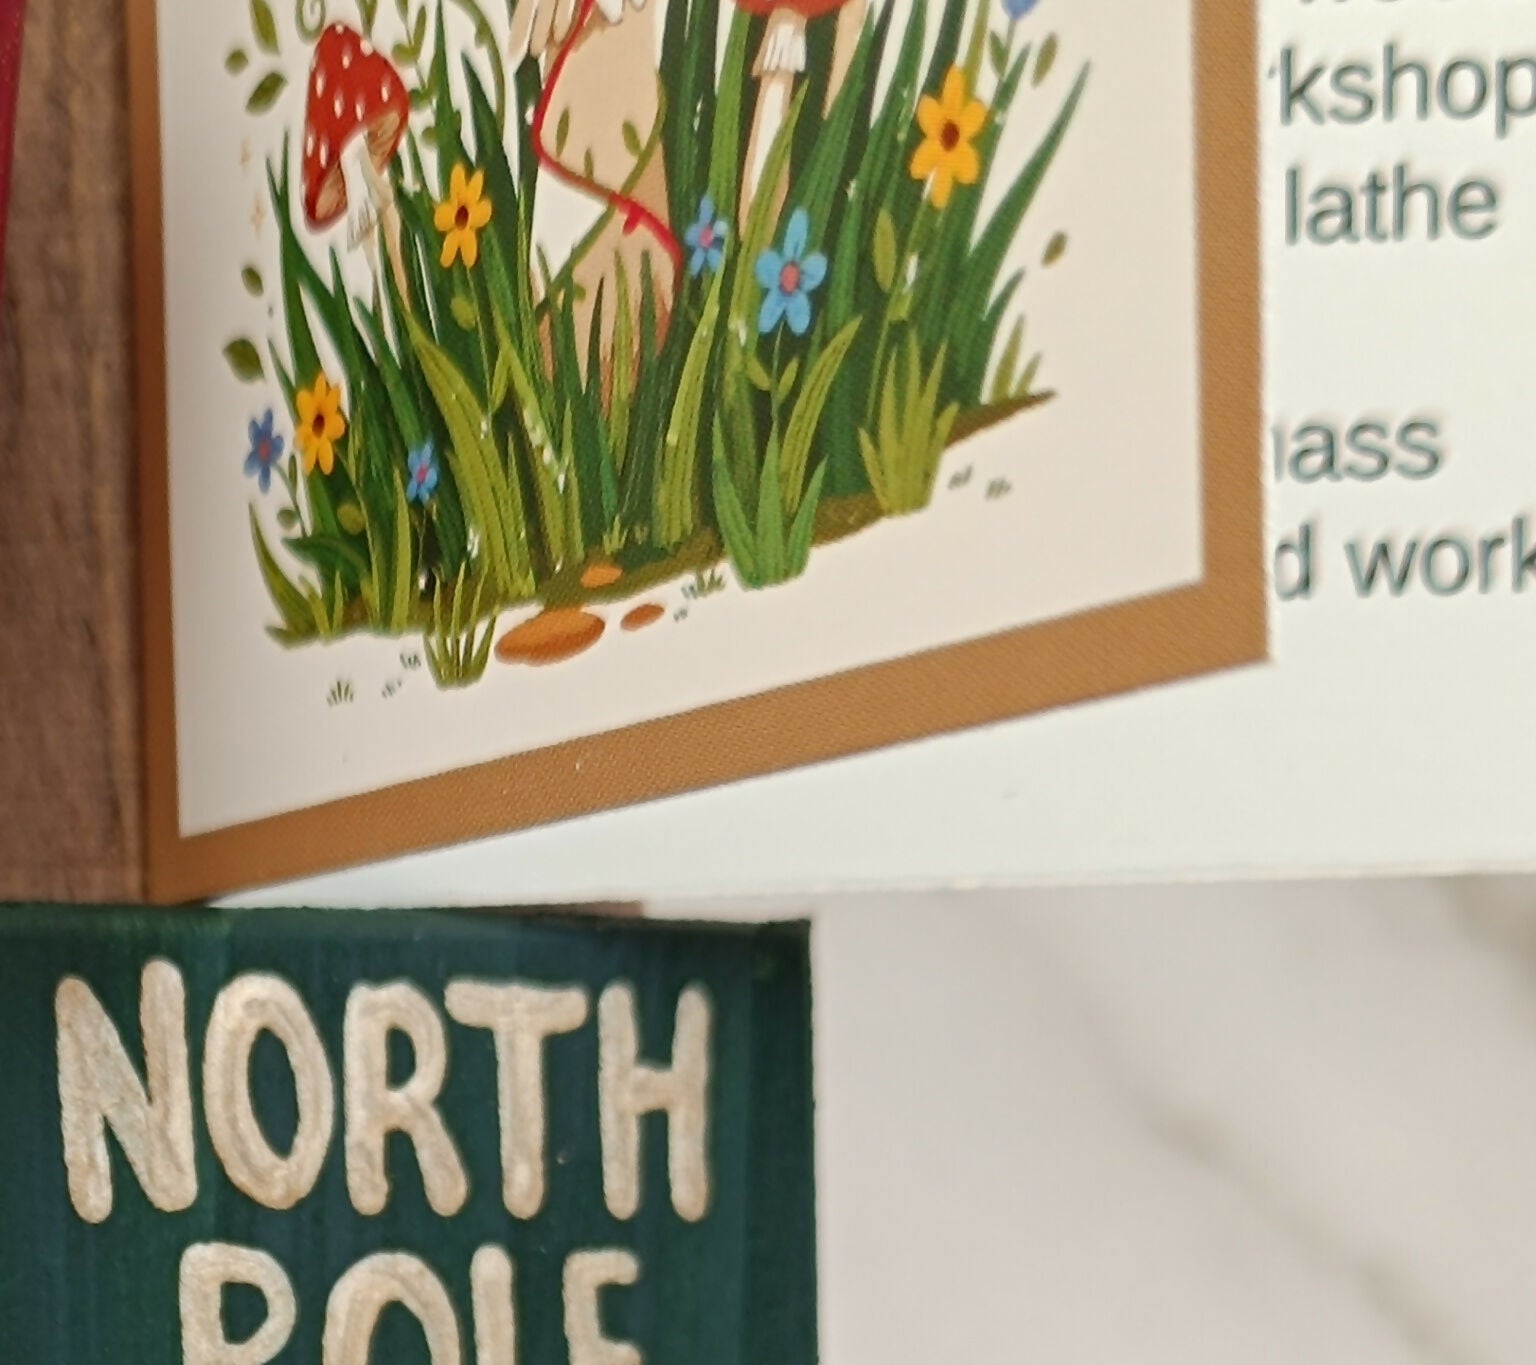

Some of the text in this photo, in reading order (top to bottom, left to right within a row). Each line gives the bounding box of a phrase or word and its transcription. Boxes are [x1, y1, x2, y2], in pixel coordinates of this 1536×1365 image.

[1268, 42, 1536, 138] kshop
[1285, 164, 1499, 245] lathe
[55, 956, 711, 1224] NORTH
